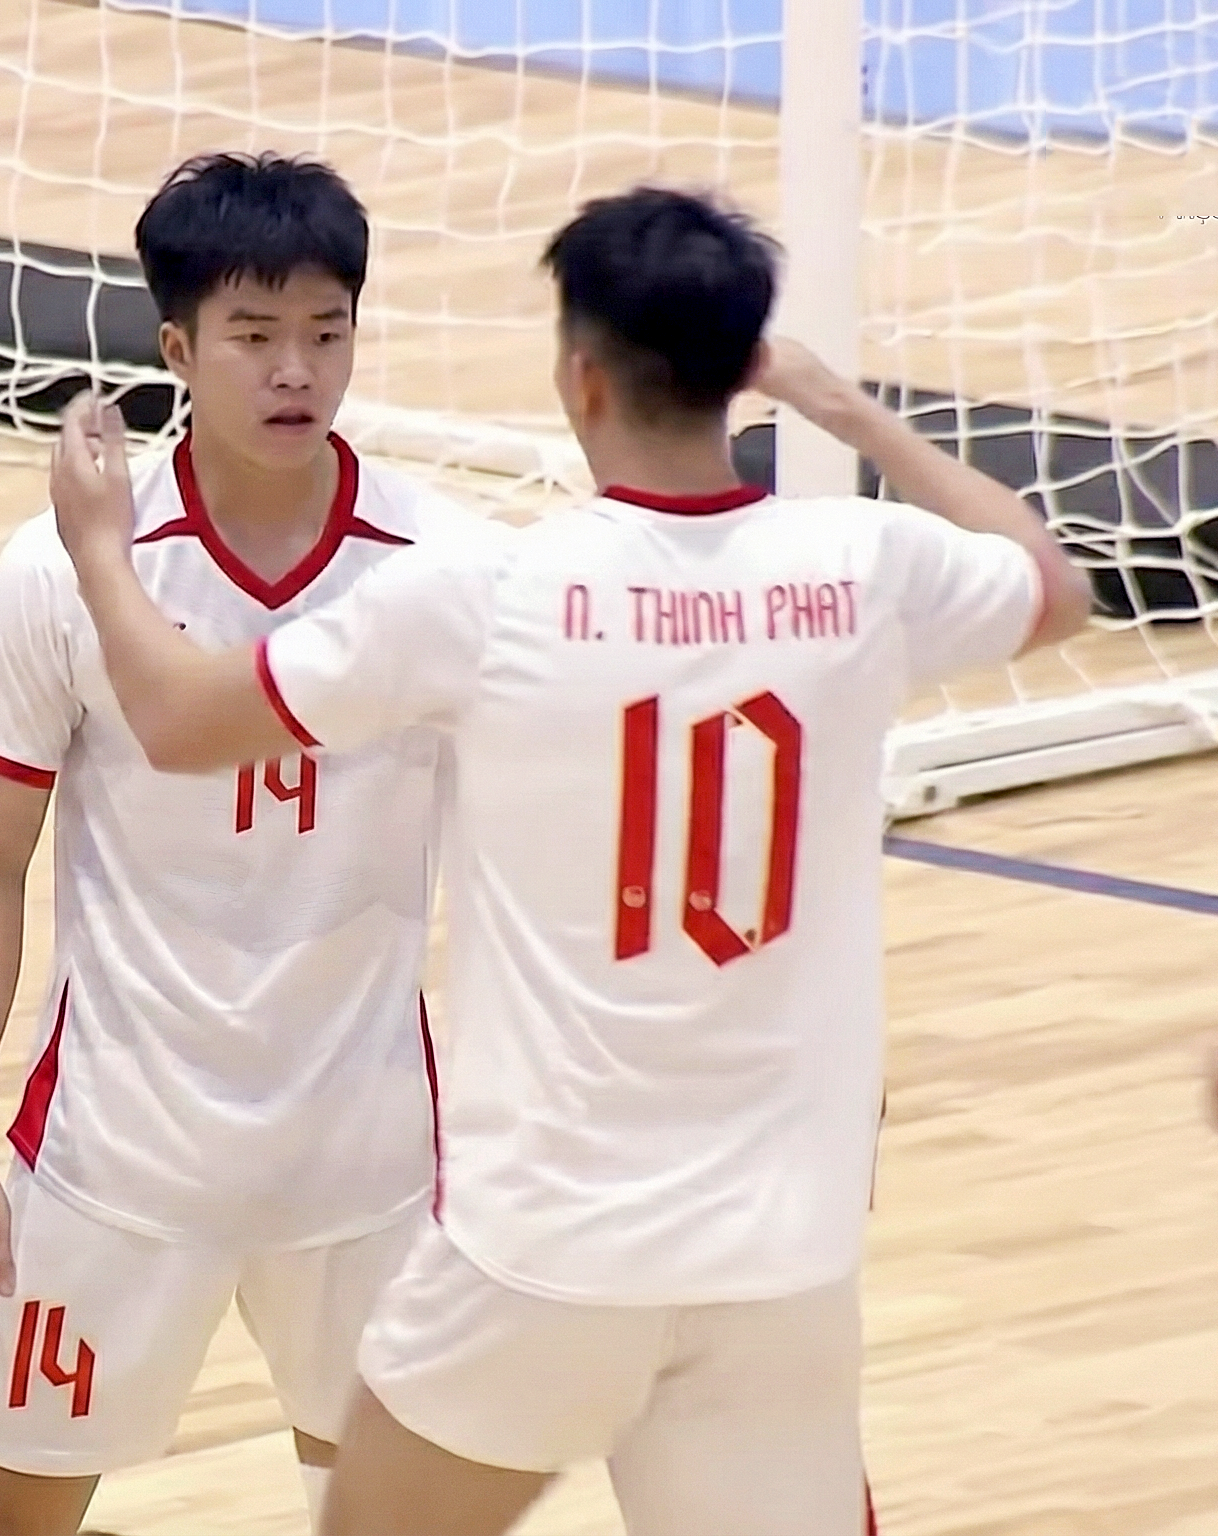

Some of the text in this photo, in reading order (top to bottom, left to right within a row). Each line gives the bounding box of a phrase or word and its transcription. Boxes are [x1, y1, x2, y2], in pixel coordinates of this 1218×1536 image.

[628, 586, 747, 645] THINH
[766, 580, 856, 641] PHAT
[235, 752, 317, 834] 14
[613, 690, 801, 967] 10
[9, 1299, 96, 1419] 14
